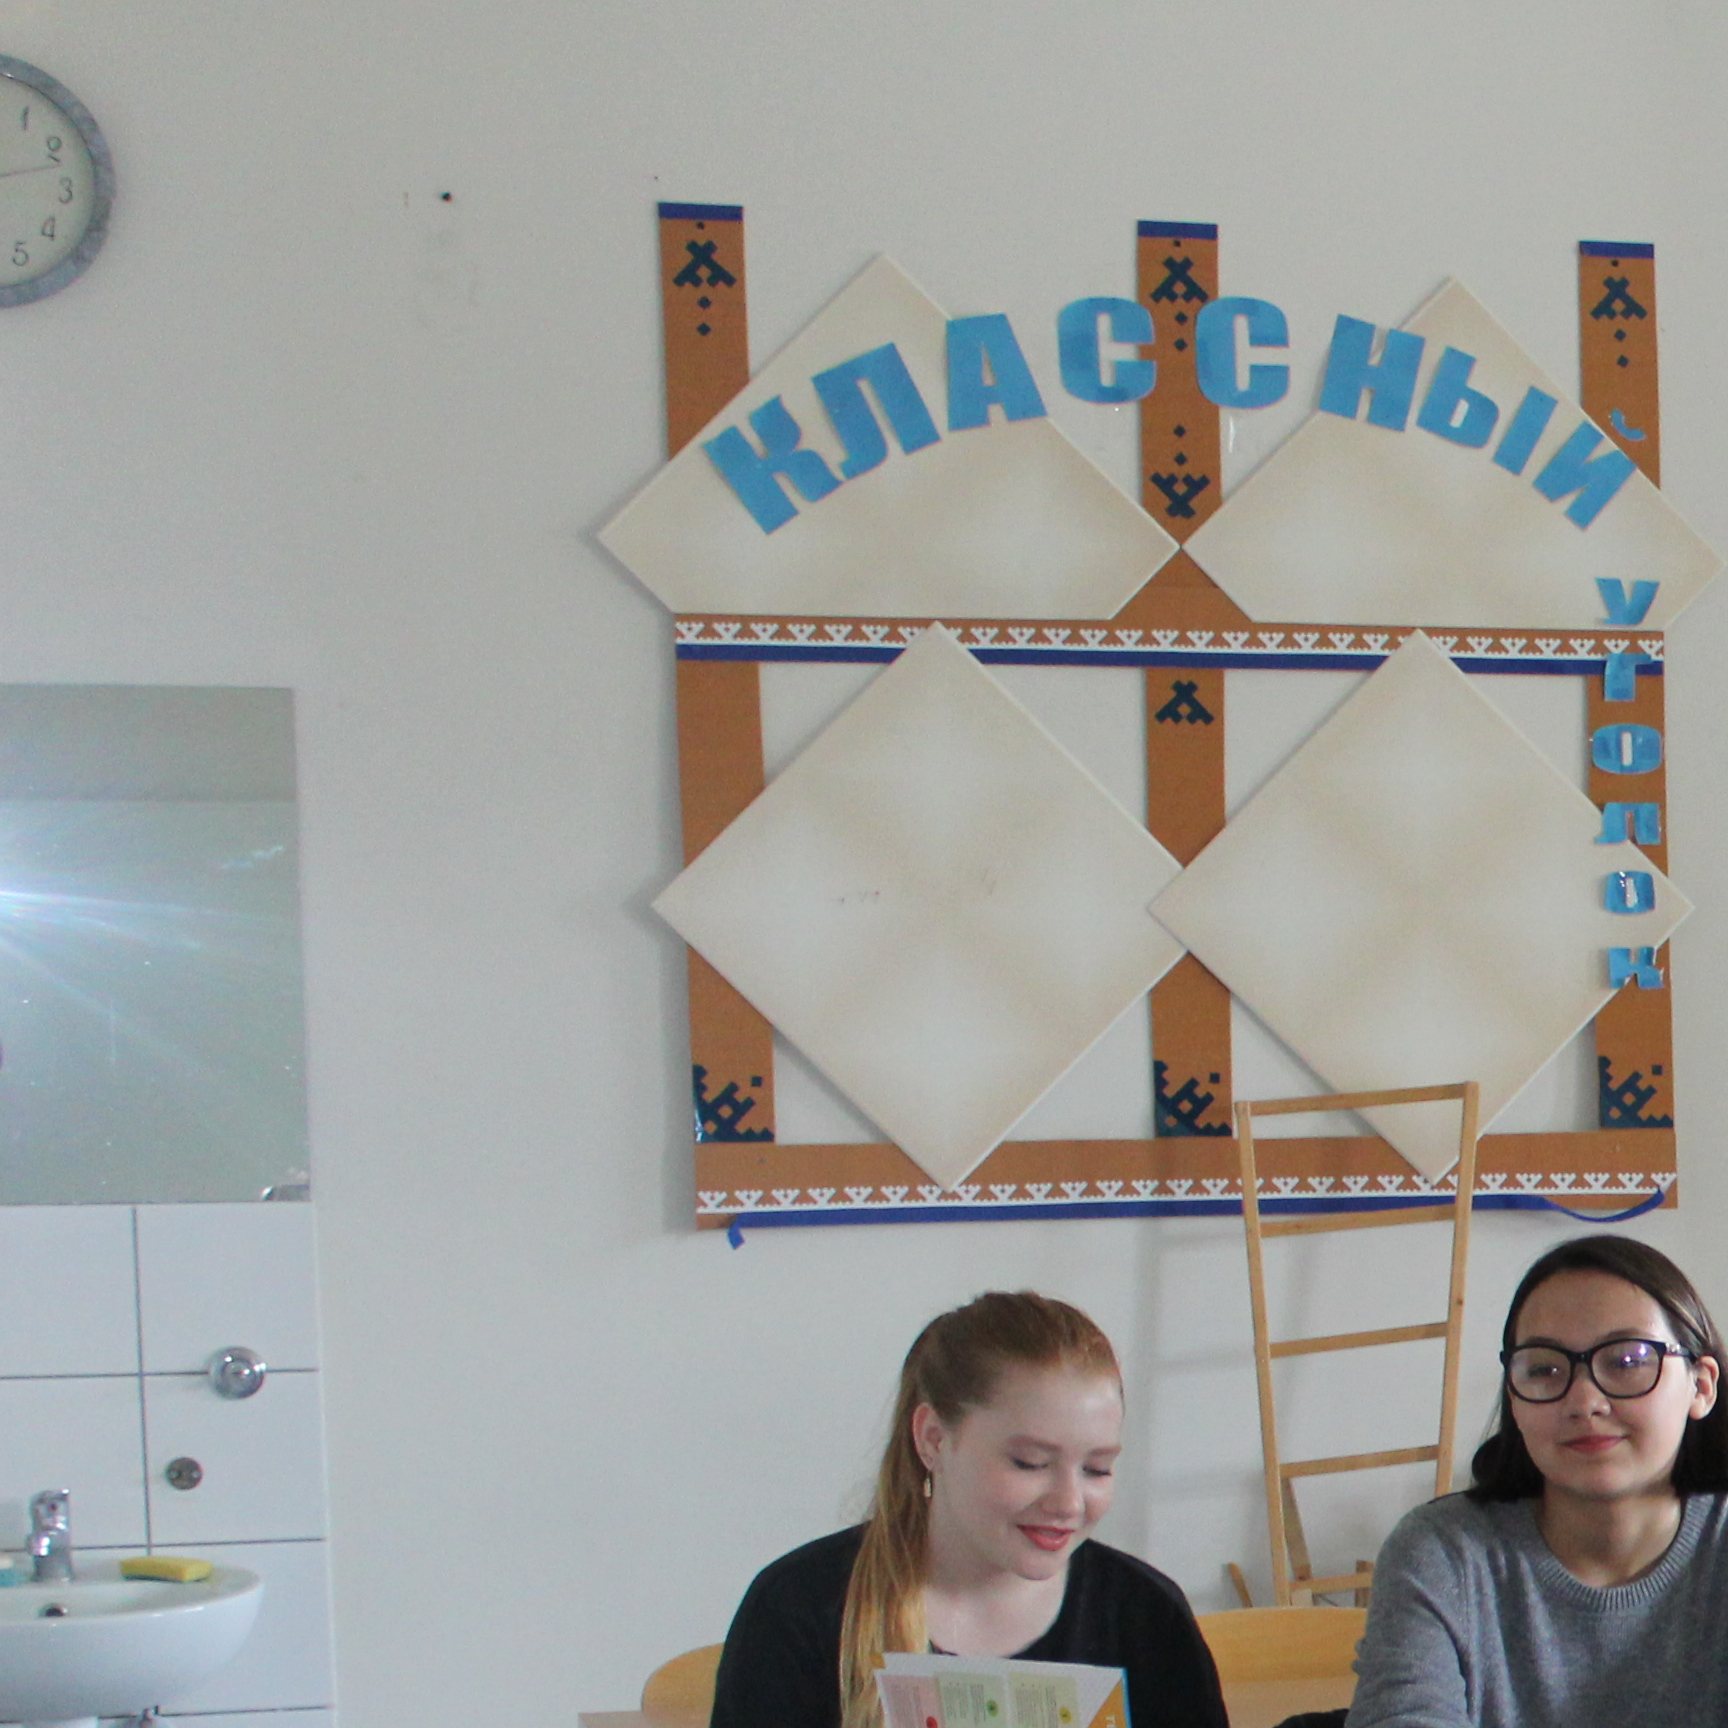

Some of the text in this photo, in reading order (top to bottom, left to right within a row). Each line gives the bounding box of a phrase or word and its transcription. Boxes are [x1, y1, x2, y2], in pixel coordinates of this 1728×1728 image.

[21, 106, 29, 131] 1
[48, 136, 62, 164] 2
[59, 177, 74, 205] 3
[41, 217, 57, 242] 4
[12, 240, 30, 268] 5
[703, 296, 1646, 534] КЛАССНЫЙ
[1590, 577, 1667, 990] УГОЛОК
